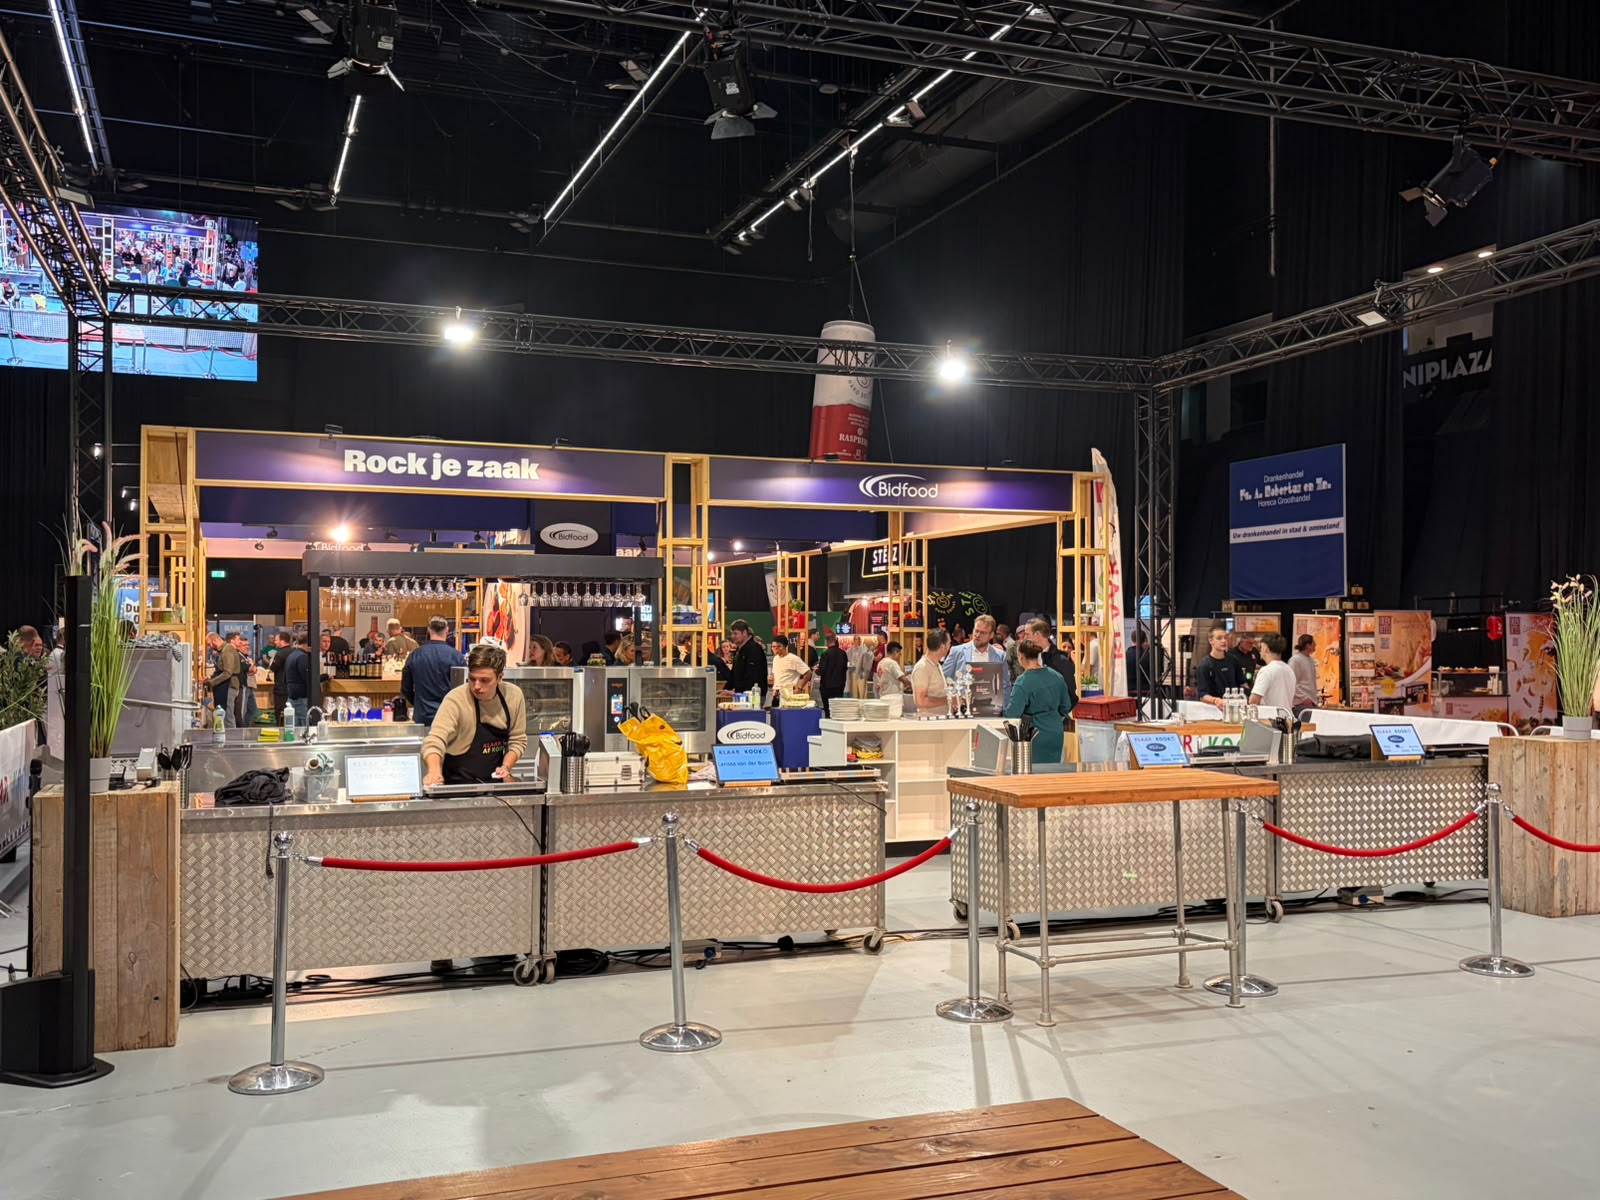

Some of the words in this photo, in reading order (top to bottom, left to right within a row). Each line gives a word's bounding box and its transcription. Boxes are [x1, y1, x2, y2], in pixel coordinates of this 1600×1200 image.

[344, 449, 428, 476] Rock
[430, 452, 462, 481] je
[466, 458, 541, 481] zaak
[1264, 471, 1304, 483] Drankenhandel
[878, 481, 939, 499] Bidfood
[1303, 481, 1315, 492] en
[1257, 498, 1277, 508] Horeca
[1277, 493, 1312, 506] Groothandel
[557, 532, 589, 542] Bidfood
[1232, 532, 1242, 540] Uw
[1242, 528, 1282, 539] drankenhandel
[1289, 525, 1302, 535] stad
[1302, 525, 1308, 533] &
[1308, 521, 1341, 533] ommeland
[321, 542, 364, 552] Bidfood
[872, 545, 898, 565] STËZ
[735, 731, 766, 740] Bidfood
